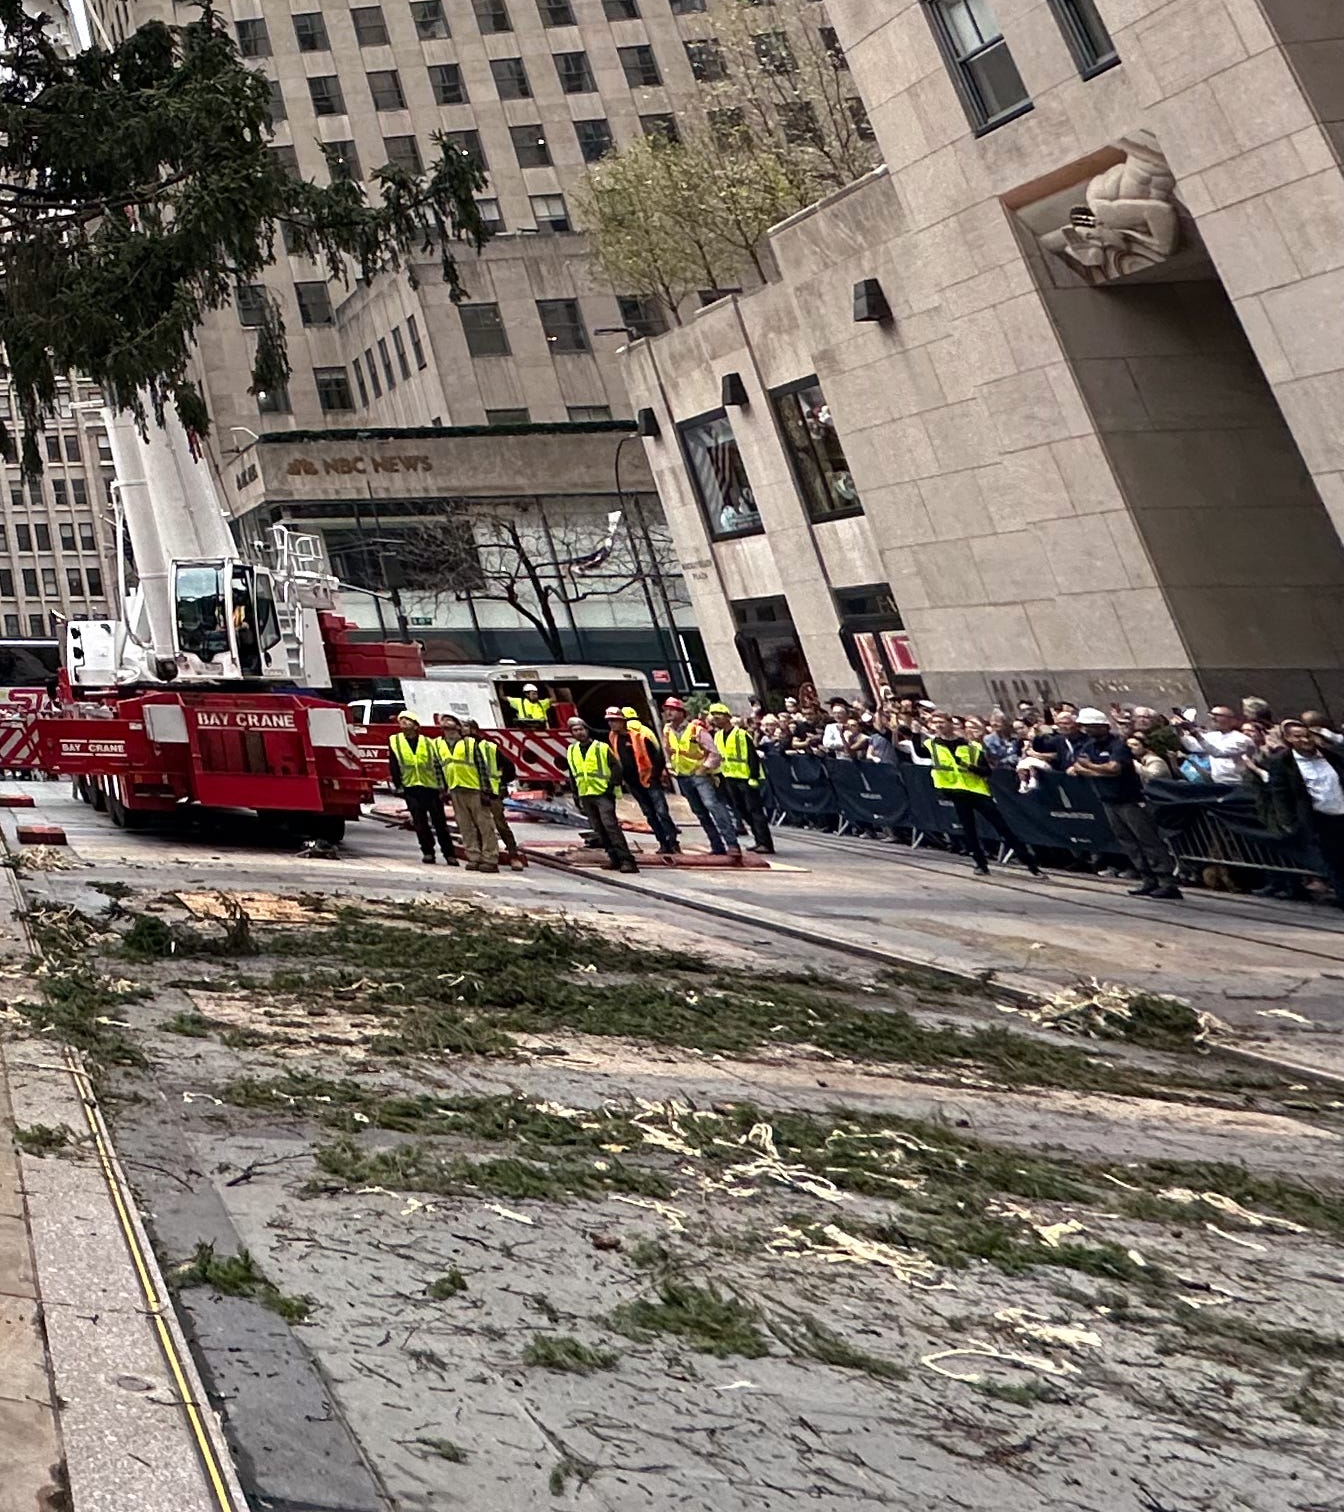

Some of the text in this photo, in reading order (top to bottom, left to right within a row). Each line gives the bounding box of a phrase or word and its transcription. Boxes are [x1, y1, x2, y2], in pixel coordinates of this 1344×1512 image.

[322, 455, 433, 476] NBC NEWS
[197, 712, 295, 728] BAY CRANE
[61, 743, 124, 753] BAY CRANE
